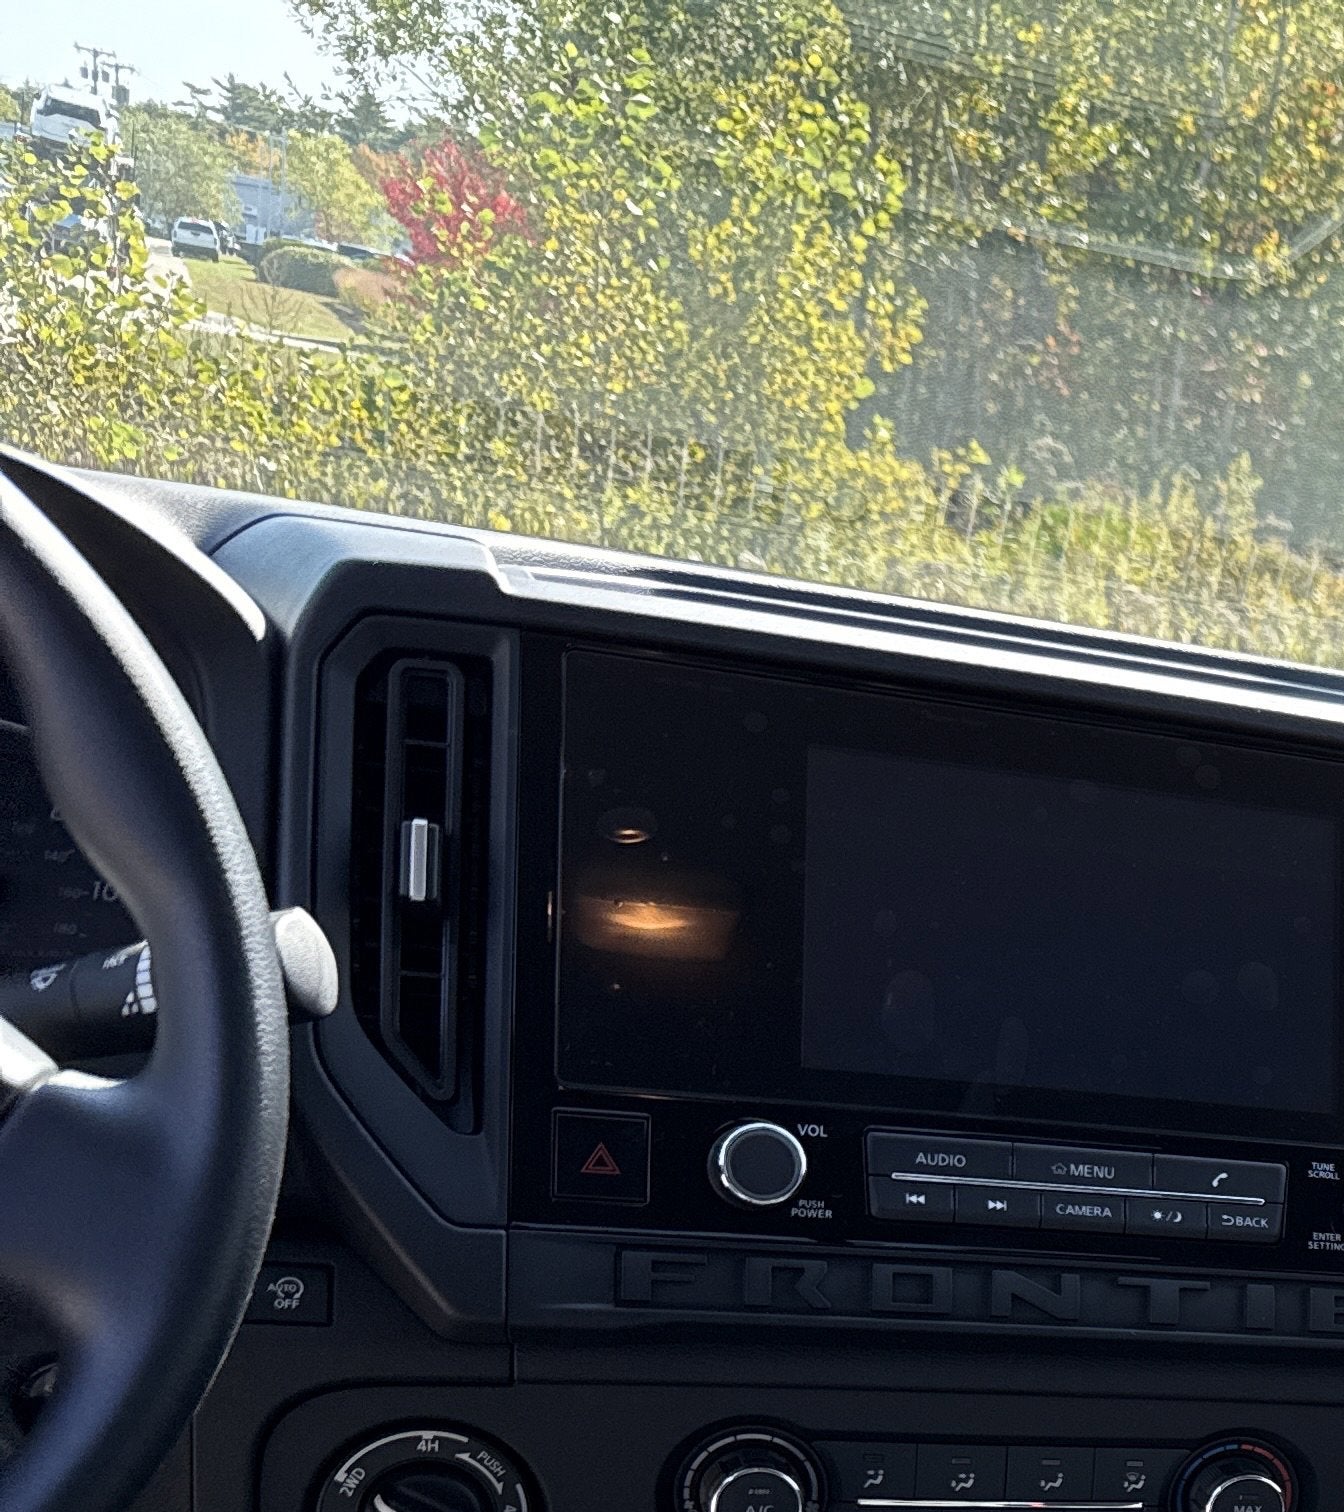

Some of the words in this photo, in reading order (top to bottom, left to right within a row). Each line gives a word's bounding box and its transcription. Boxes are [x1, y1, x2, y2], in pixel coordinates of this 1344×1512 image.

[797, 1124, 828, 1138] VOL
[915, 1152, 966, 1168] AUDIO
[1311, 1162, 1335, 1172] TUNE
[1069, 1163, 1115, 1179] MENU
[1308, 1170, 1340, 1181] SCROLL
[798, 1200, 824, 1209] PUSH
[1056, 1203, 1112, 1218] CAMERA
[791, 1208, 832, 1219] POWER
[1236, 1214, 1269, 1228] BACK
[1312, 1232, 1342, 1243] ENTER
[268, 1282, 298, 1293] AUTO
[274, 1298, 300, 1310] OFF
[416, 1439, 439, 1453] 4H
[477, 1450, 507, 1479] PUSH
[339, 1466, 367, 1498] 2WD
